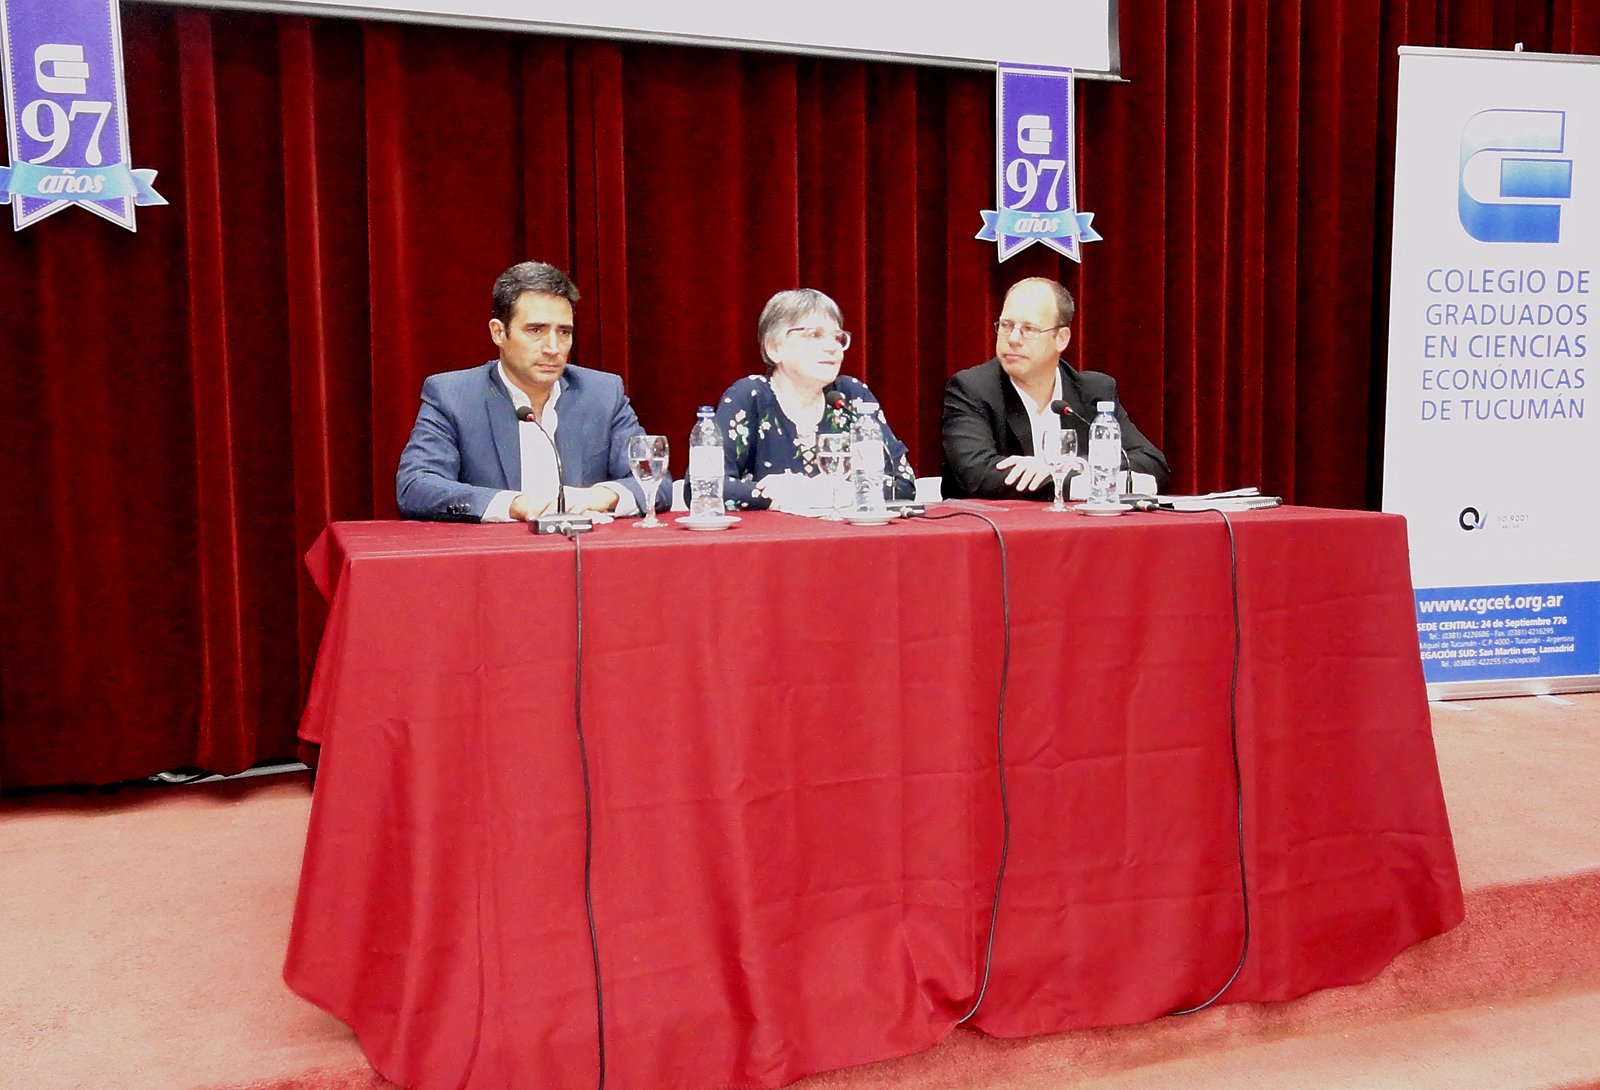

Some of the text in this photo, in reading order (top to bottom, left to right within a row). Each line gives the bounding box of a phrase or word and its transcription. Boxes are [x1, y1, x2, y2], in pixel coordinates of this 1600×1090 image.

[21, 99, 112, 166] 97
[37, 169, 106, 194] años
[1006, 158, 1066, 211] 97
[1014, 214, 1060, 233] años
[1427, 269, 1590, 294] COLEGIO DE
[1426, 303, 1588, 326] GRADUADOS
[1424, 334, 1587, 358] EN CIENCIAS
[1422, 364, 1586, 391] ECONÓMICAS
[1421, 393, 1585, 421] DE TUCUMÁN
[1419, 595, 1564, 614] www.cgcet.org.ar
[1417, 615, 1568, 632] SEDE CENTRAL: 24 de Septiembre 776
[1420, 649, 1457, 660] EGACIÓN
[1458, 649, 1478, 658] SUD:
[1478, 648, 1494, 657] San
[1539, 643, 1575, 654] Lamadrid
